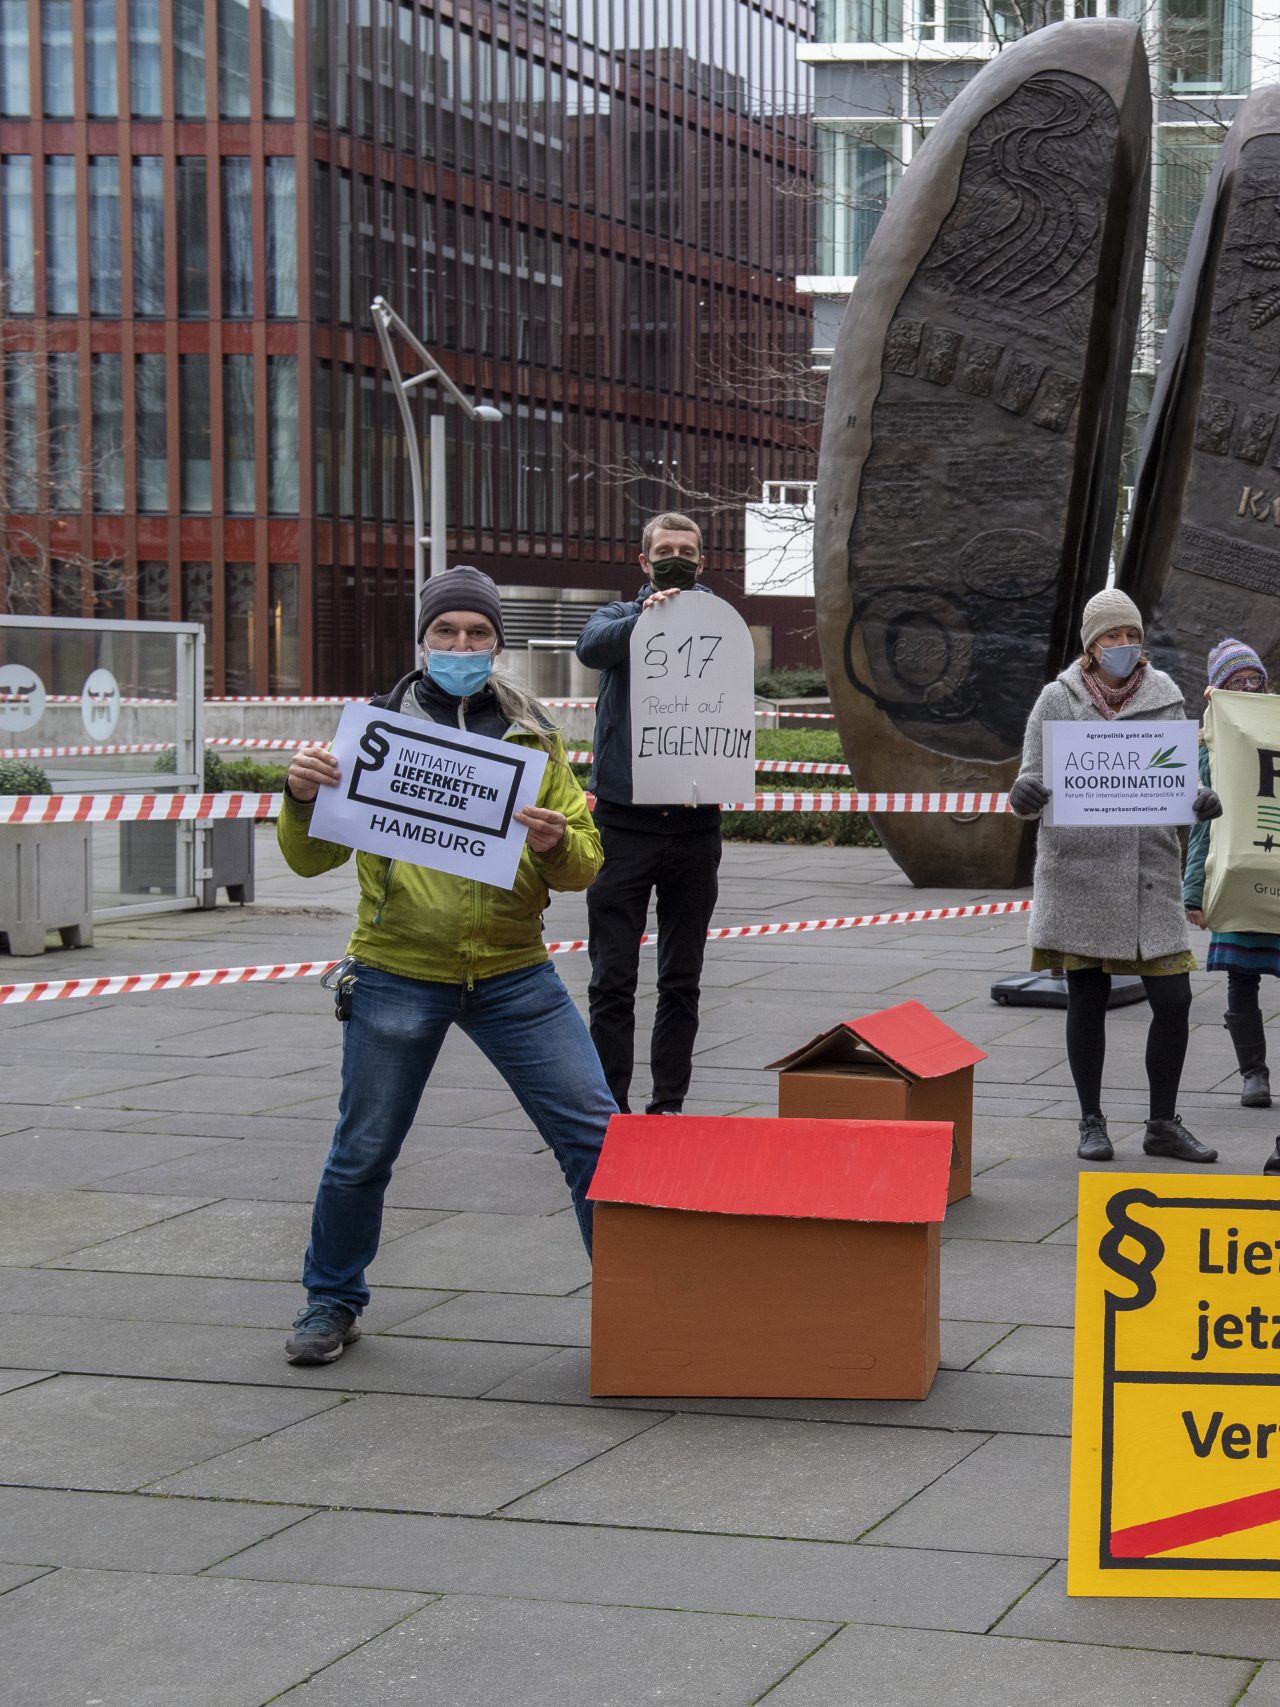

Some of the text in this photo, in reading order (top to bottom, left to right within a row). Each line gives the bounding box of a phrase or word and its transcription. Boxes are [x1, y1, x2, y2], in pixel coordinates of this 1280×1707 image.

[642, 693, 726, 714] Recht auf
[638, 726, 752, 759] EIGENTUM
[1086, 732, 1125, 740] Agrarpolitik
[1126, 732, 1140, 740] geht
[398, 748, 476, 780] INITIATIVE
[1065, 751, 1140, 771] AGRAR
[393, 763, 498, 802] LIEFERKETTEN
[1065, 775, 1185, 789] KOORDINATION
[390, 780, 468, 811] GESETZ.DE
[1140, 791, 1175, 799] Agrarpolitik
[1083, 805, 1168, 813] www.agrarkoordination.de
[369, 814, 486, 857] HAMBURG
